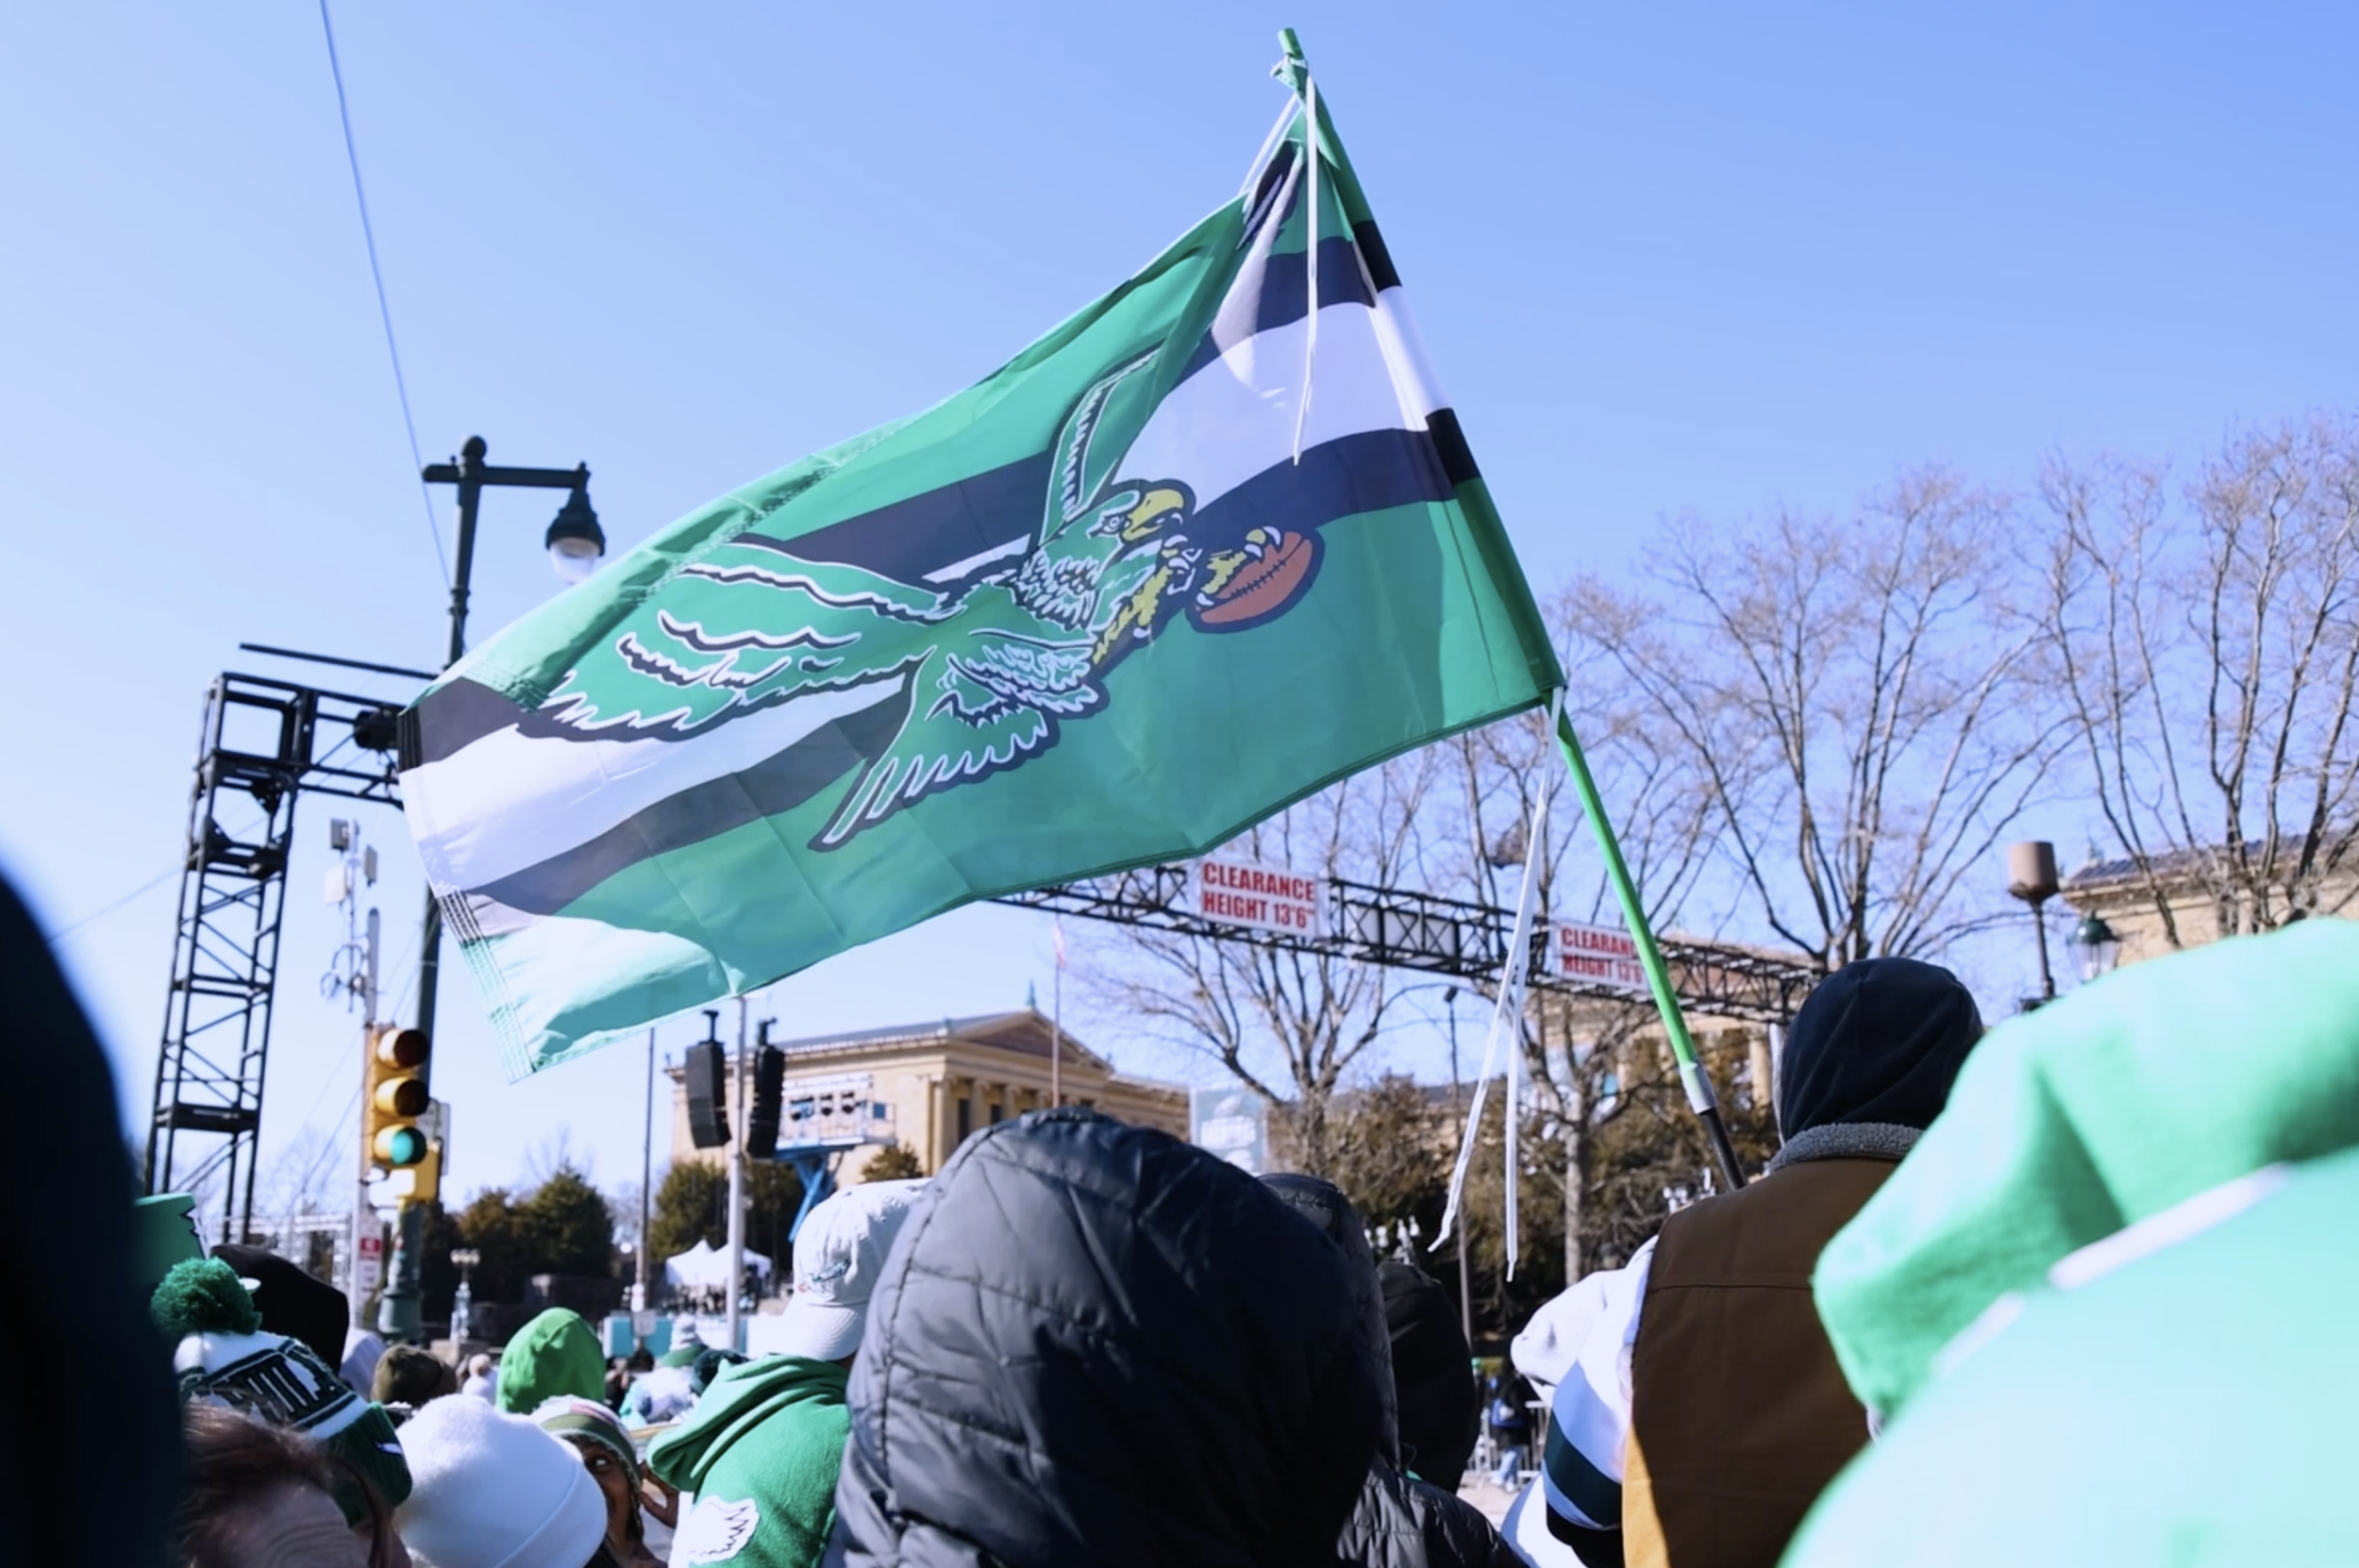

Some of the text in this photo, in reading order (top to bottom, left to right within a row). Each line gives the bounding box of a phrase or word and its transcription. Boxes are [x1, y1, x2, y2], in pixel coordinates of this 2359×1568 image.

[1203, 862, 1314, 902] CLEARANCE
[1203, 892, 1267, 922] HEIGHT
[1562, 927, 1639, 959] CLEARANC
[1562, 953, 1612, 979] HEIGHT
